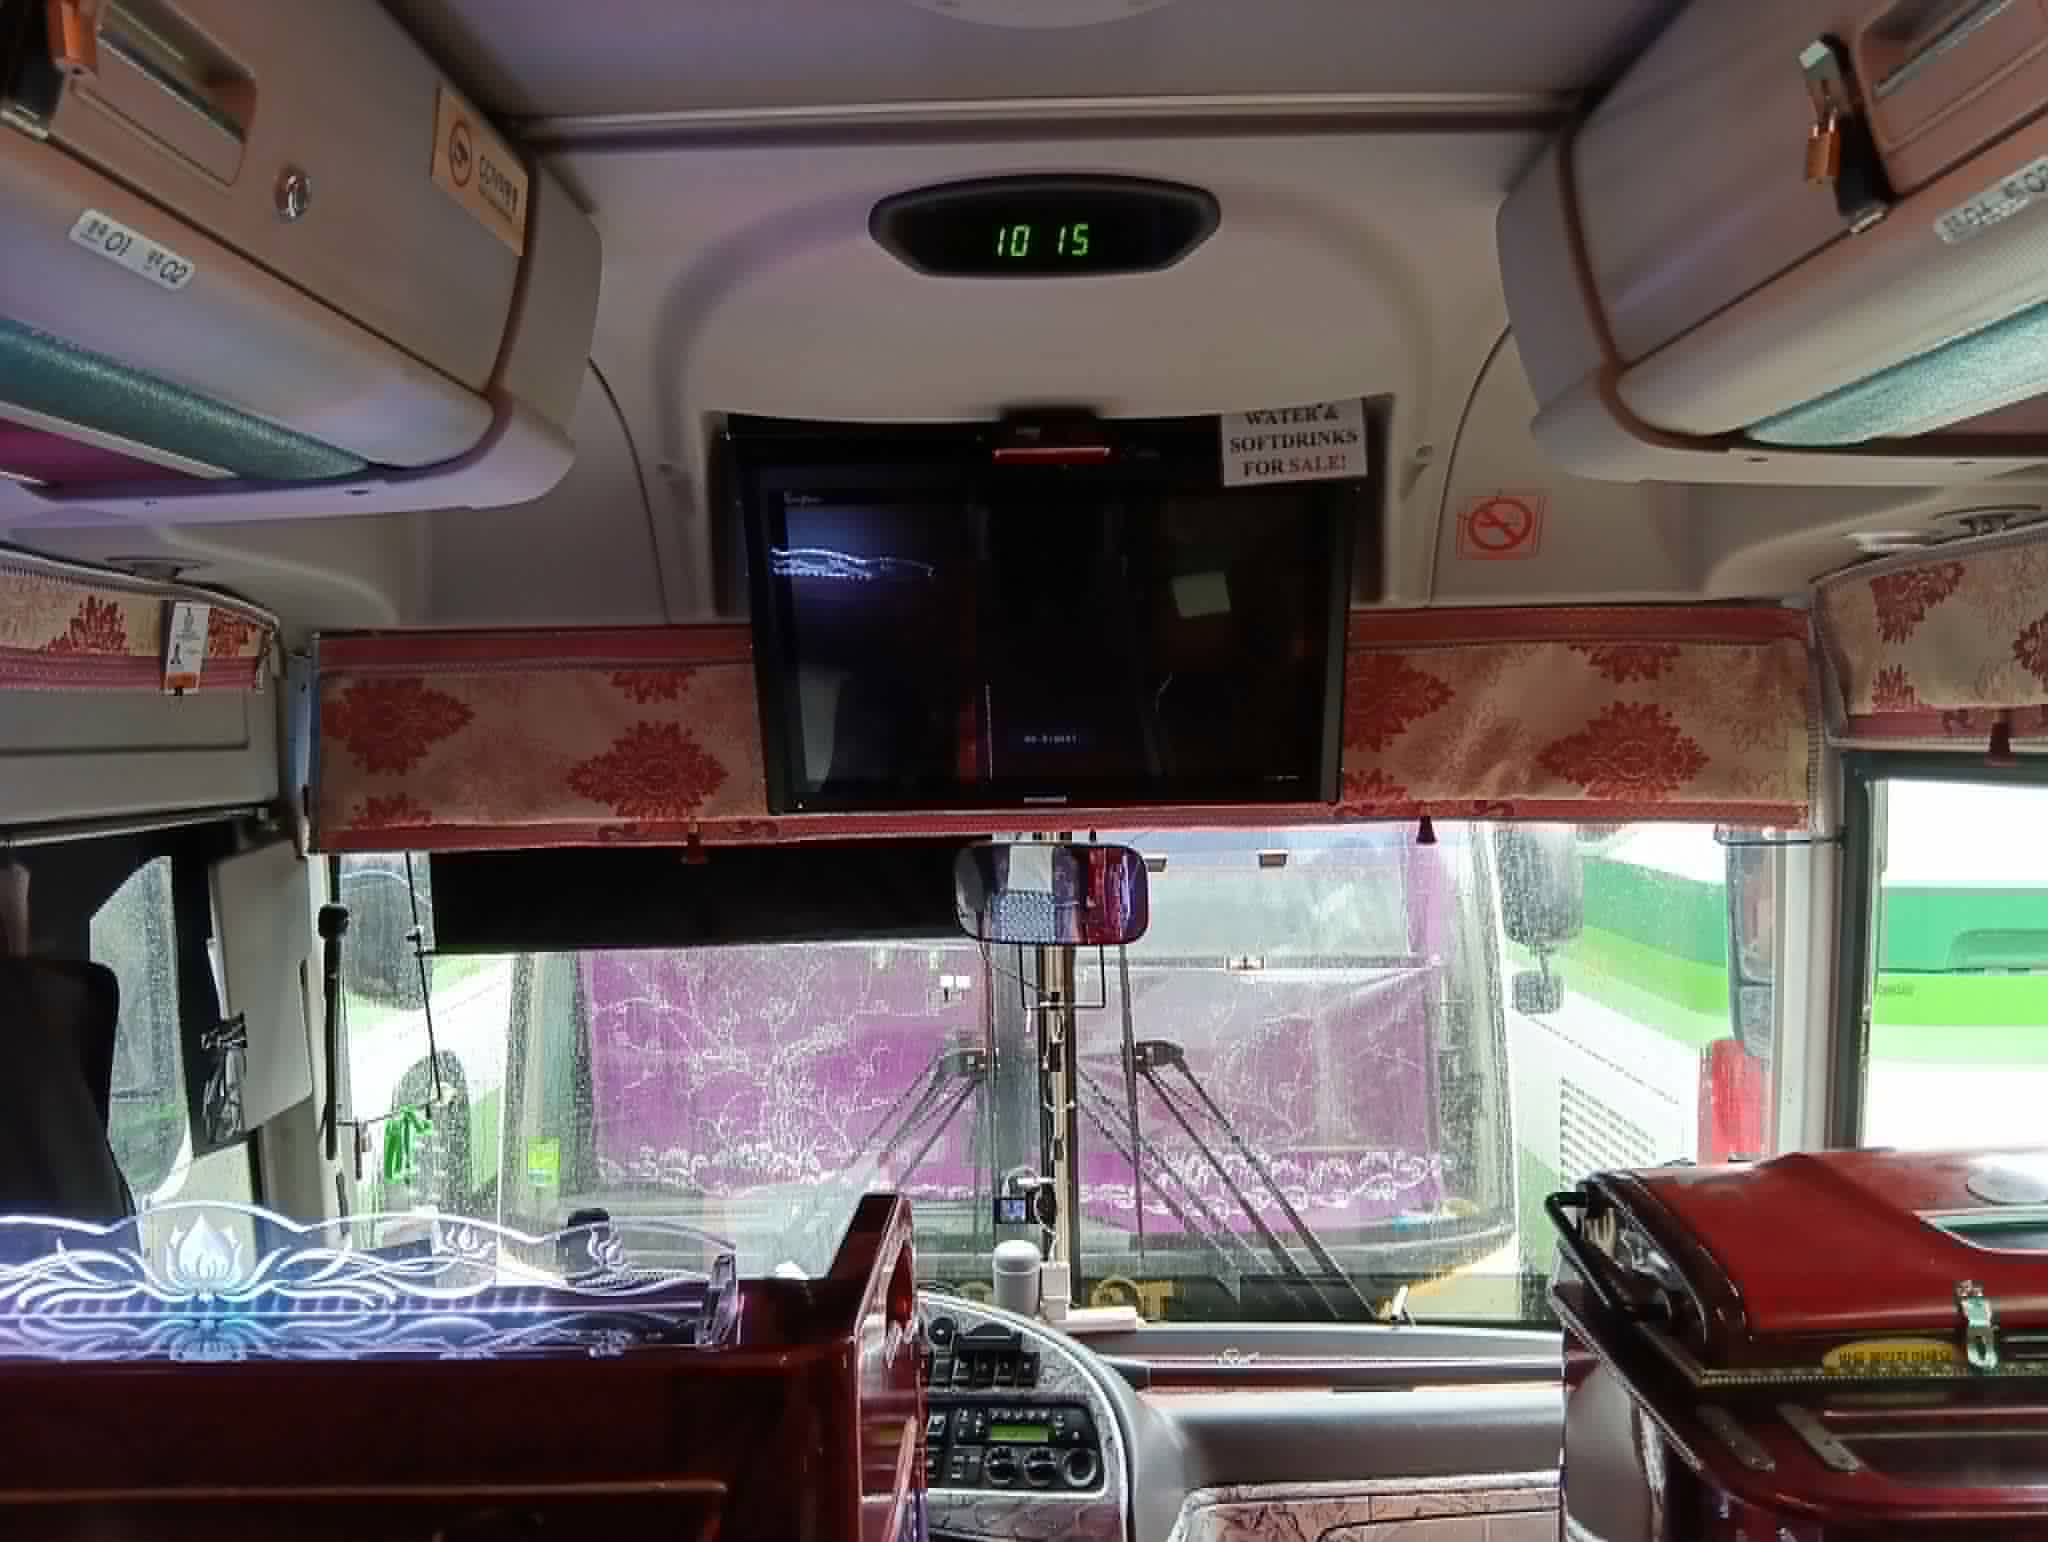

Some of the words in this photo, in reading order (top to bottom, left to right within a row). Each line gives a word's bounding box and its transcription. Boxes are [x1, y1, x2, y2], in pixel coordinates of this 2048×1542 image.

[997, 224, 1031, 257] 10
[1057, 223, 1089, 256] 15
[1245, 406, 1318, 425] WATER
[1229, 429, 1358, 454] SOFTDRINKS
[1243, 458, 1284, 477] FOR
[1286, 455, 1346, 474] SALE!
